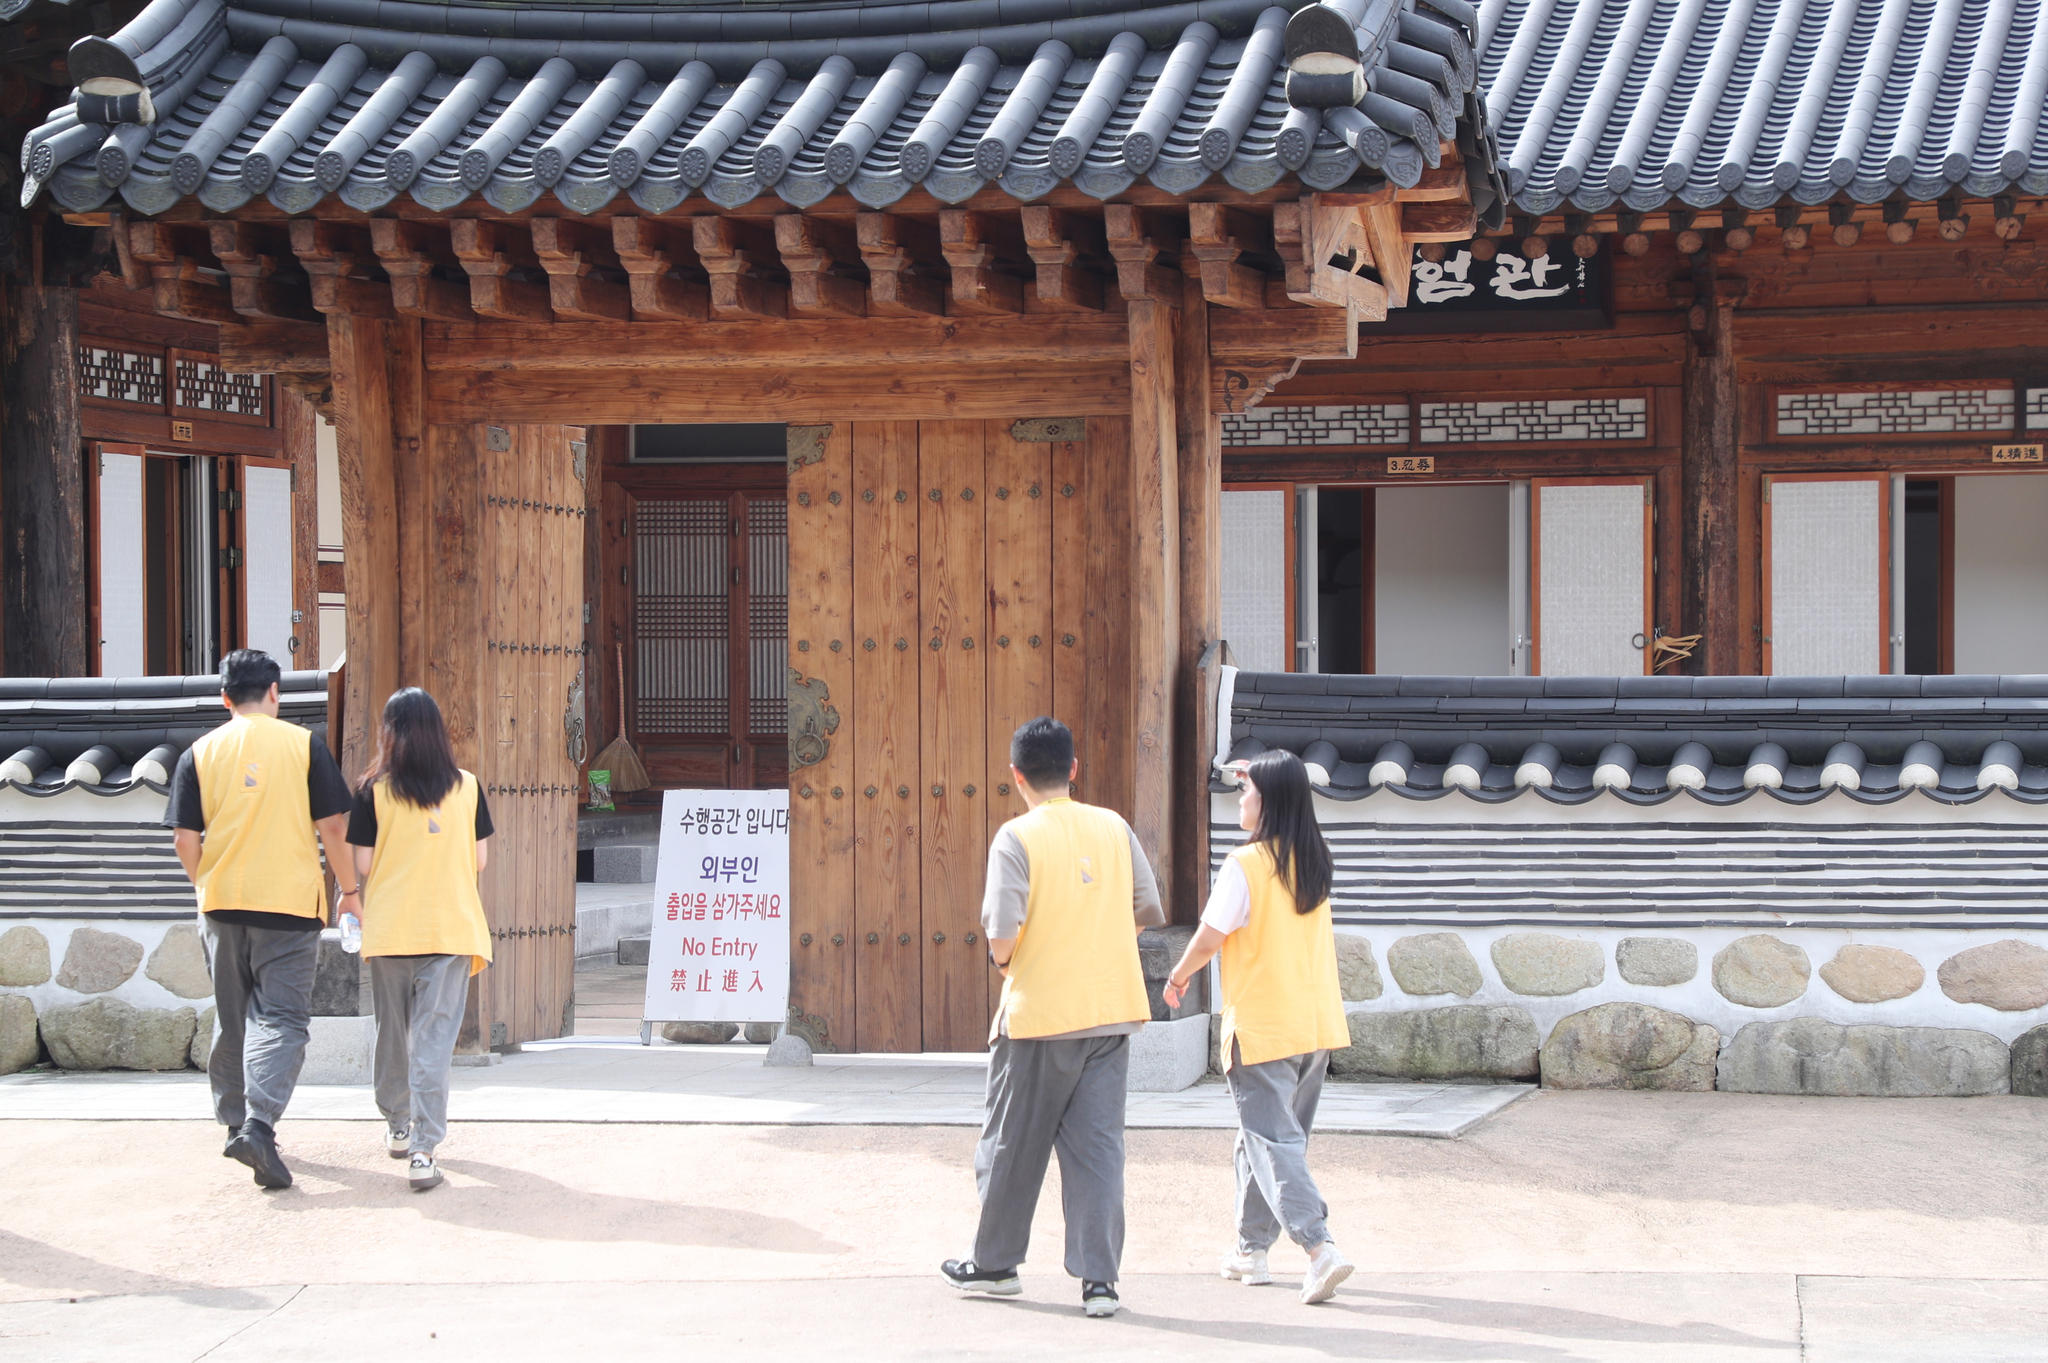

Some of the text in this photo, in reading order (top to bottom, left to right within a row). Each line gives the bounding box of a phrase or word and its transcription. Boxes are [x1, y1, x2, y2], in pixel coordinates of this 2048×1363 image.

[680, 807, 789, 835] 수행공간 입니다
[699, 856, 759, 884] 외부인
[666, 892, 781, 921] 출입을 삼가주세요
[682, 937, 758, 961] No Entry
[670, 969, 764, 993] 禁止進入
